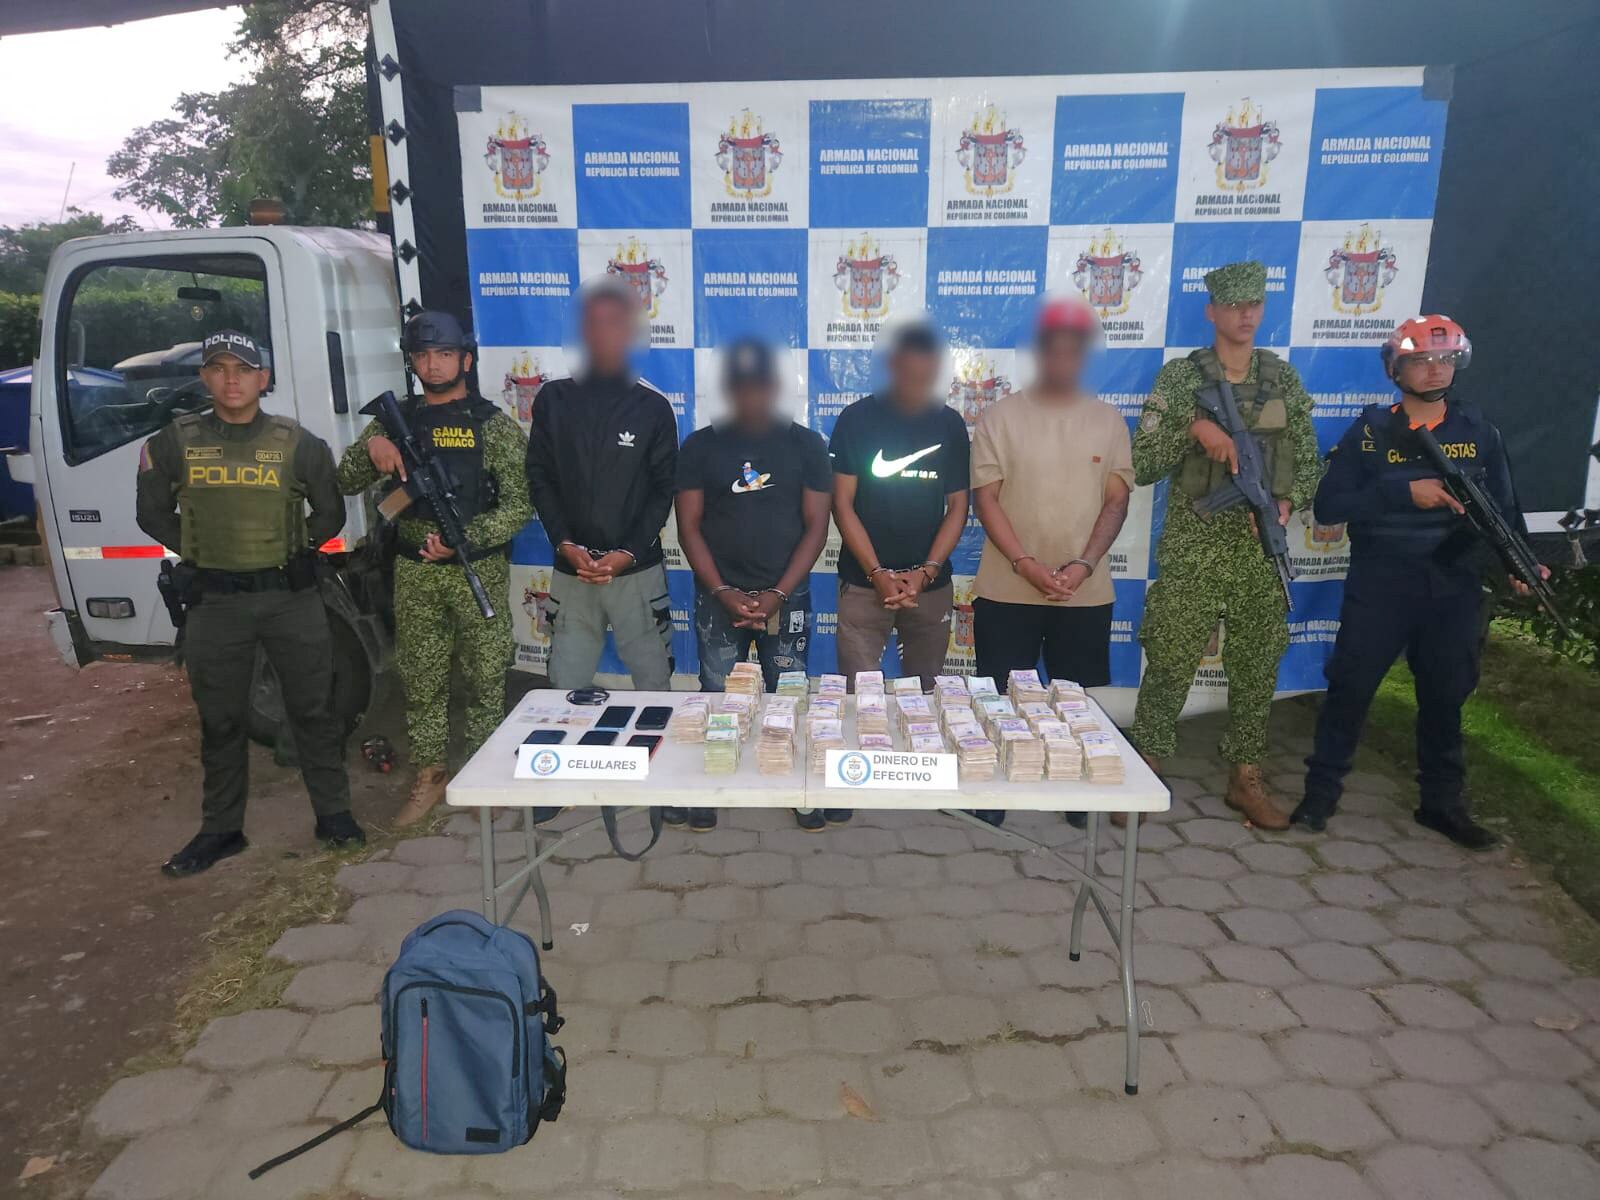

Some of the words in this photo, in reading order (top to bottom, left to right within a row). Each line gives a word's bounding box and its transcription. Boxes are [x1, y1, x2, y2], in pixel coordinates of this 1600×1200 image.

[1321, 138, 1372, 151] ARMADA
[1374, 136, 1431, 149] NACIONAL
[820, 149, 865, 161] ARMADA
[867, 148, 919, 161] NACIONAL
[1064, 144, 1112, 157] ARMADA
[1113, 142, 1168, 156] NACIONAL
[584, 152, 627, 164] ARMADA
[630, 152, 680, 164] NACIONAL
[1371, 153, 1382, 163] DE
[1384, 152, 1429, 163] COLOMBIA
[865, 165, 875, 174] DE
[877, 164, 918, 174] COLOMBIA
[1111, 160, 1121, 170] DE
[1123, 158, 1167, 169] COLOMBIA
[629, 167, 639, 177] DE
[640, 167, 680, 177] COLOMBIA
[947, 200, 984, 210] ARMADA
[985, 199, 1028, 209] NACIONAL
[1195, 195, 1234, 205] ARMADA
[1236, 193, 1281, 204] NACIONAL
[482, 203, 516, 213] ARMADA
[518, 203, 557, 213] NACIONAL
[711, 202, 746, 212] ARMADA
[748, 202, 788, 212] NACIONAL
[1244, 206, 1280, 215] COLOMBIA
[479, 272, 518, 285] ARMADA
[520, 272, 570, 285] NACIONAL
[704, 272, 746, 285] ARMADA
[748, 272, 798, 285] NACIONAL
[938, 271, 983, 283] ARMADA
[984, 269, 1037, 283] NACIONAL
[519, 287, 529, 296] DE
[530, 287, 570, 297] COLOMBIA
[747, 287, 757, 297] DE
[758, 286, 798, 297] COLOMBIA
[982, 286, 993, 295] DE
[994, 285, 1036, 295] COLOMBIA
[827, 323, 861, 332] ARMADA
[1313, 319, 1351, 329] ARMADA
[1353, 319, 1395, 329] NACIONAL
[432, 426, 475, 438] GAULA
[432, 438, 475, 448] TUMACO
[189, 463, 280, 488] POLICÍA
[567, 759, 637, 770] CELULARES
[873, 754, 918, 766] DINERO
[921, 756, 938, 767] EN
[873, 770, 932, 782] EFECTIVO
